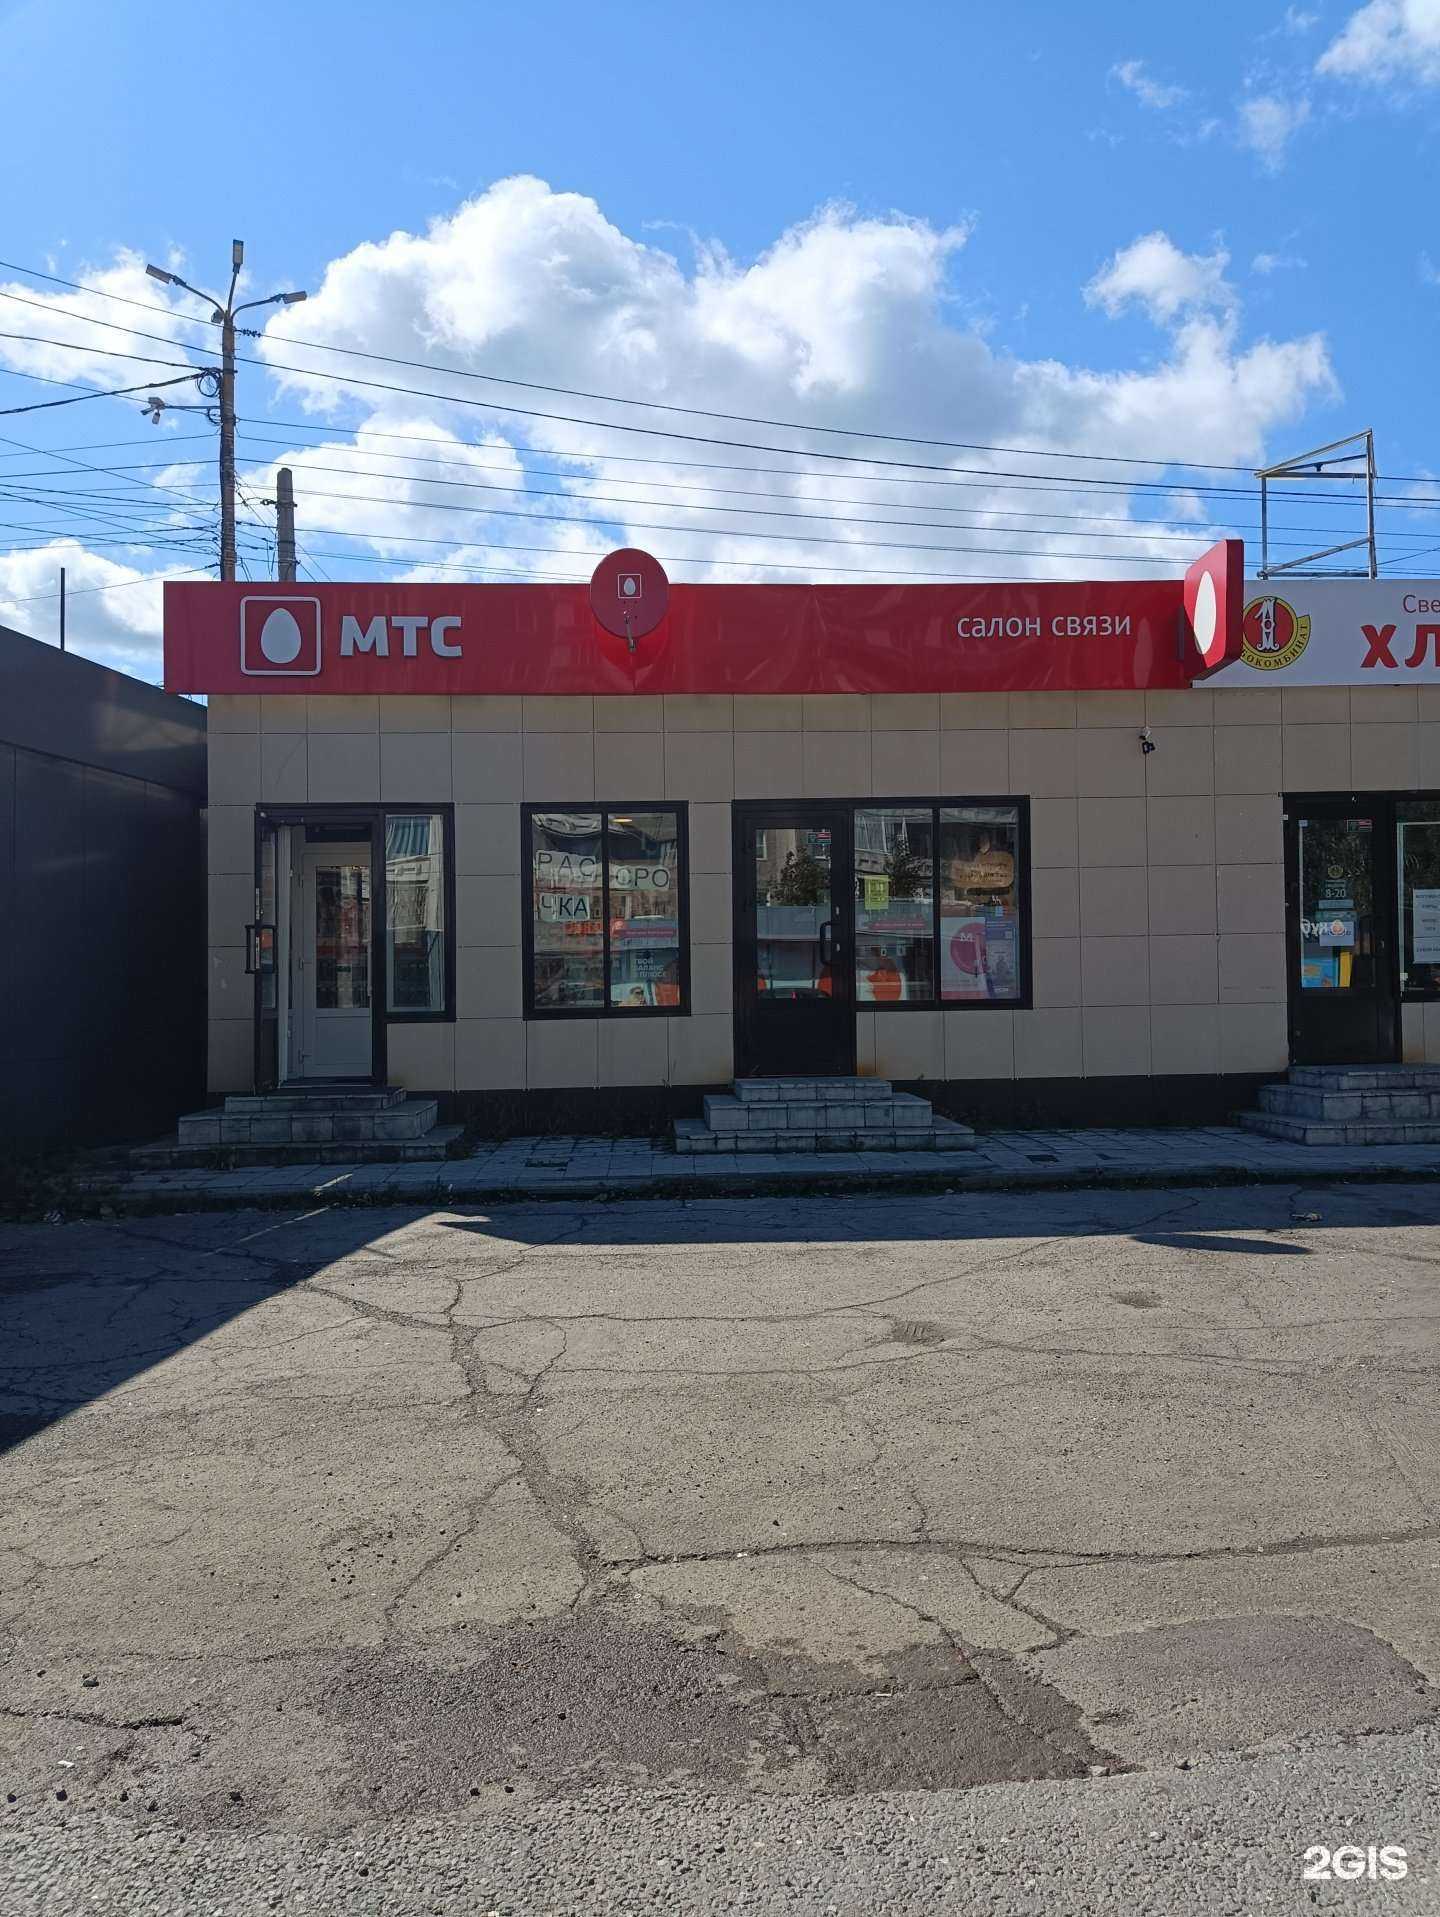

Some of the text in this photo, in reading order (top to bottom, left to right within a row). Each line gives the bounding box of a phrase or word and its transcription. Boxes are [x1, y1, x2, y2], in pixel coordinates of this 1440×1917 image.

[340, 615, 463, 657] МТС
[957, 615, 1132, 638] салон связи
[537, 852, 670, 888] РАС СРО
[541, 895, 589, 917] ЧКА
